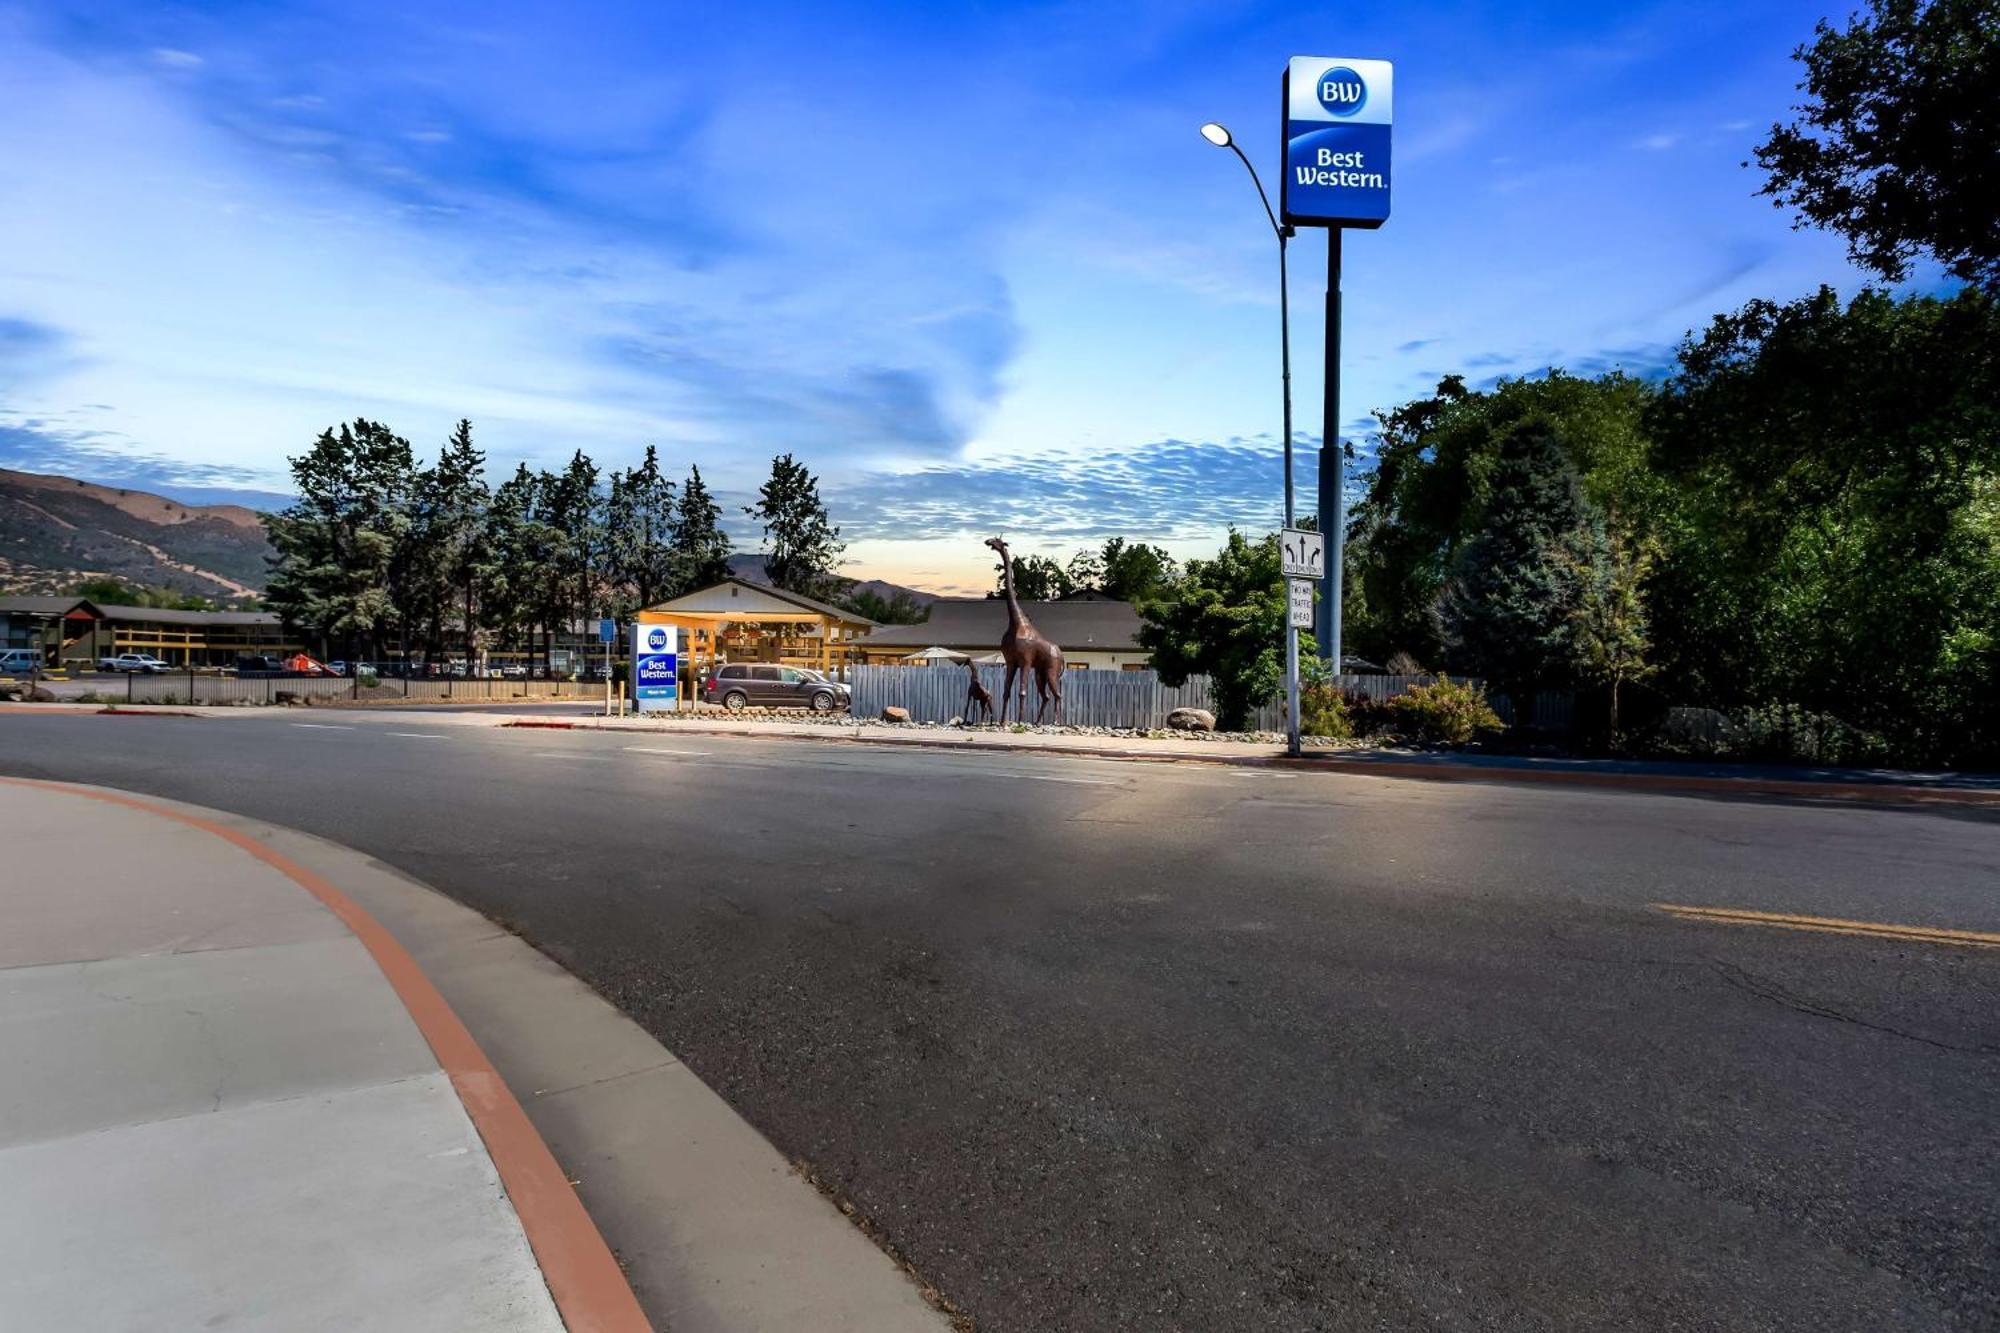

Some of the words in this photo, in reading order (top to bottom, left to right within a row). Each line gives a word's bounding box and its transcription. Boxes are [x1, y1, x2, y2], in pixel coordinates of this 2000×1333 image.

[1323, 82, 1361, 103] BW
[1317, 148, 1364, 168] Best
[1291, 585, 1301, 594] TWO
[1291, 598, 1312, 608] TRAFFIC
[1292, 612, 1310, 622] AHEAD
[650, 635, 665, 645] BW
[648, 660, 666, 670] Best
